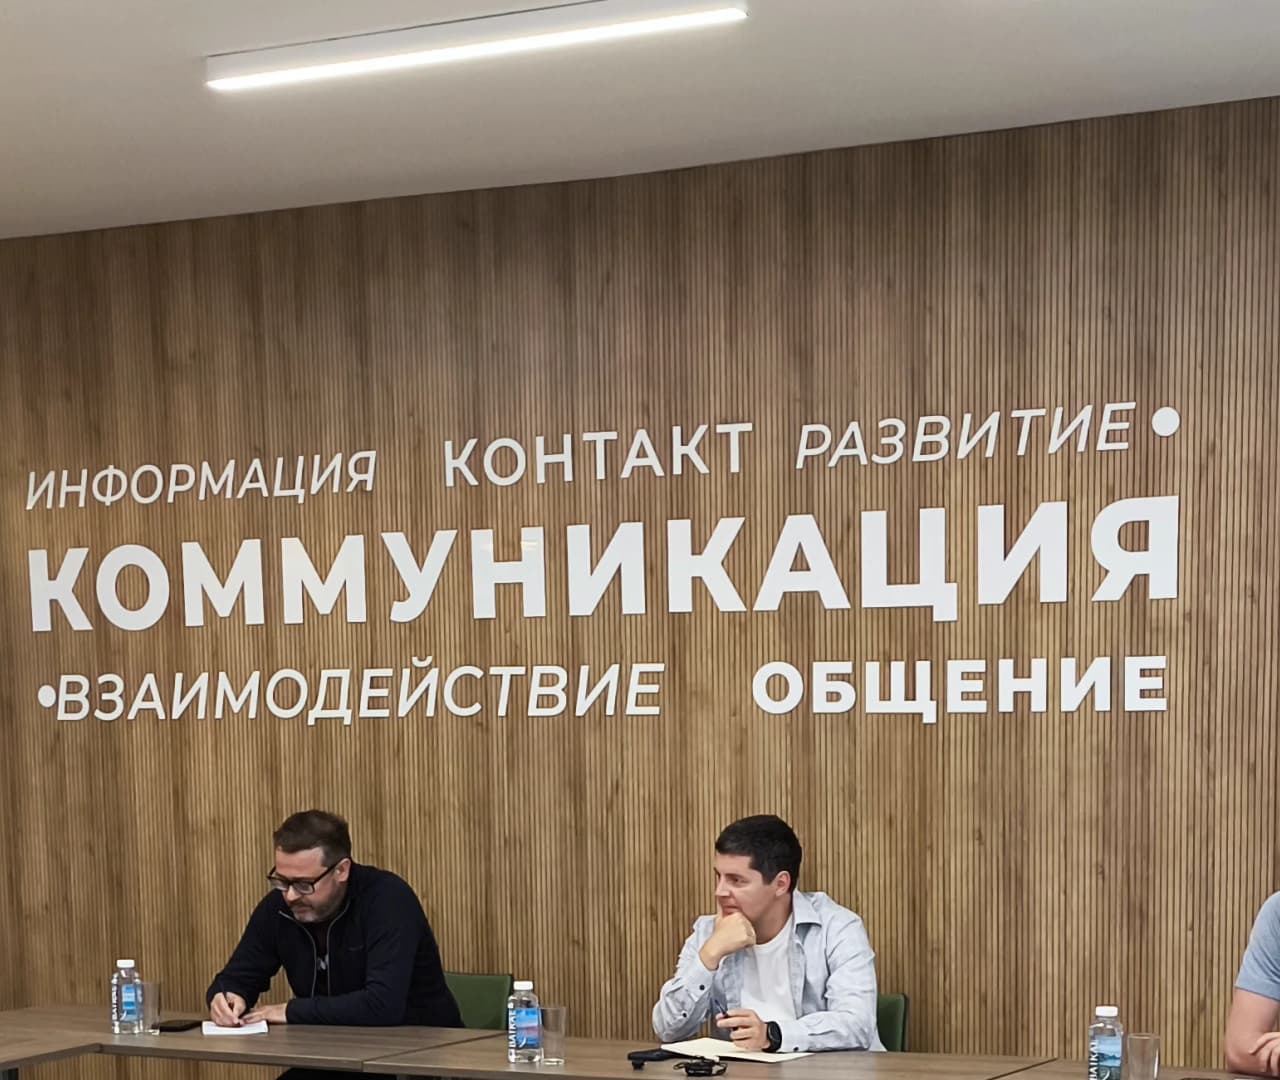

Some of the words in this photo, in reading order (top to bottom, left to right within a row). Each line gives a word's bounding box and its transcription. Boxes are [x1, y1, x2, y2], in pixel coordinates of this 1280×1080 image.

[25, 450, 377, 510] ИНФОРМАЦИЯ
[443, 422, 754, 487] КОНТАКТ
[794, 401, 1138, 470] РАЗВИТИЕ
[26, 495, 1181, 632] КОММУНИКАЦИЯ
[55, 655, 665, 725] ВЗАИМОДЕЙСТВИЕ
[751, 655, 1169, 724] ОБЩЕНИЕ
